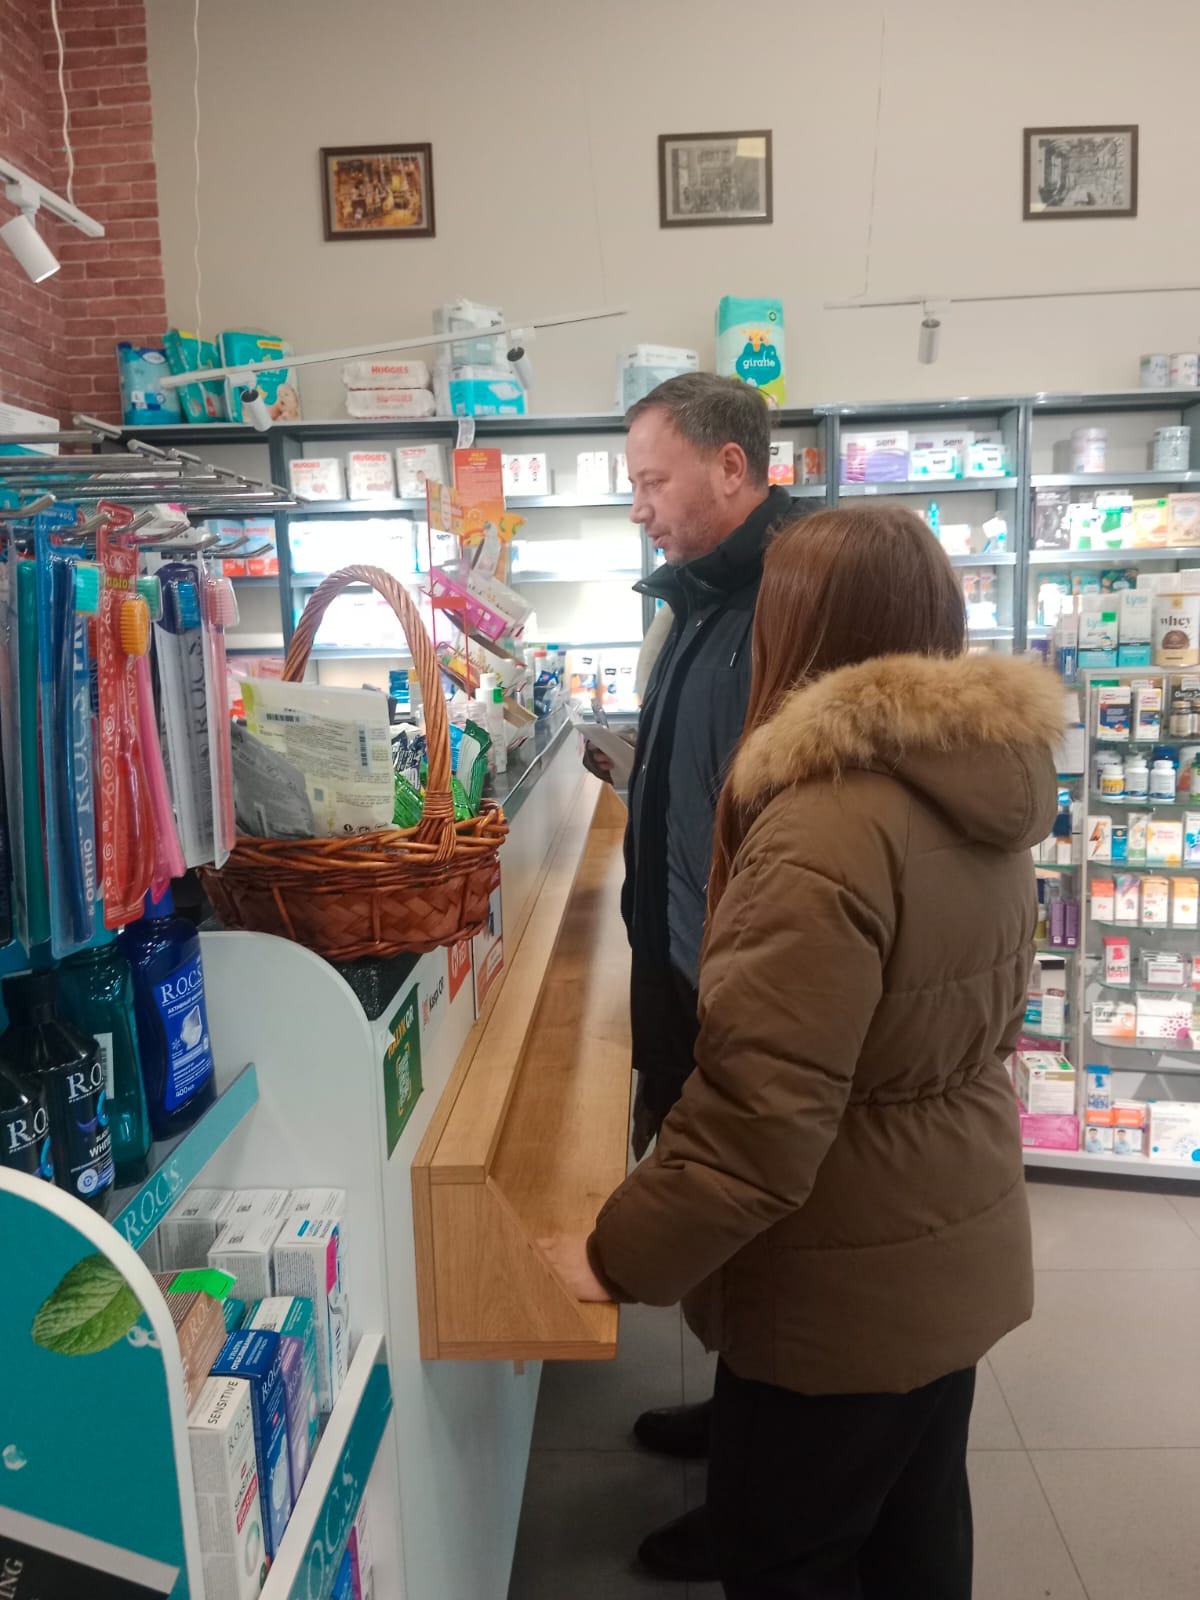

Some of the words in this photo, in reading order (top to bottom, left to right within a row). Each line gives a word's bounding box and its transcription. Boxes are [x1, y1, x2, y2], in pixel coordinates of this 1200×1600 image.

[371, 365, 409, 374] HUGGIES
[352, 453, 387, 462] HUGGIES
[292, 461, 321, 469] HUGGIES
[1160, 615, 1191, 628] whey
[84, 838, 94, 902] ORTHO
[207, 1380, 239, 1425] SENSITIVE
